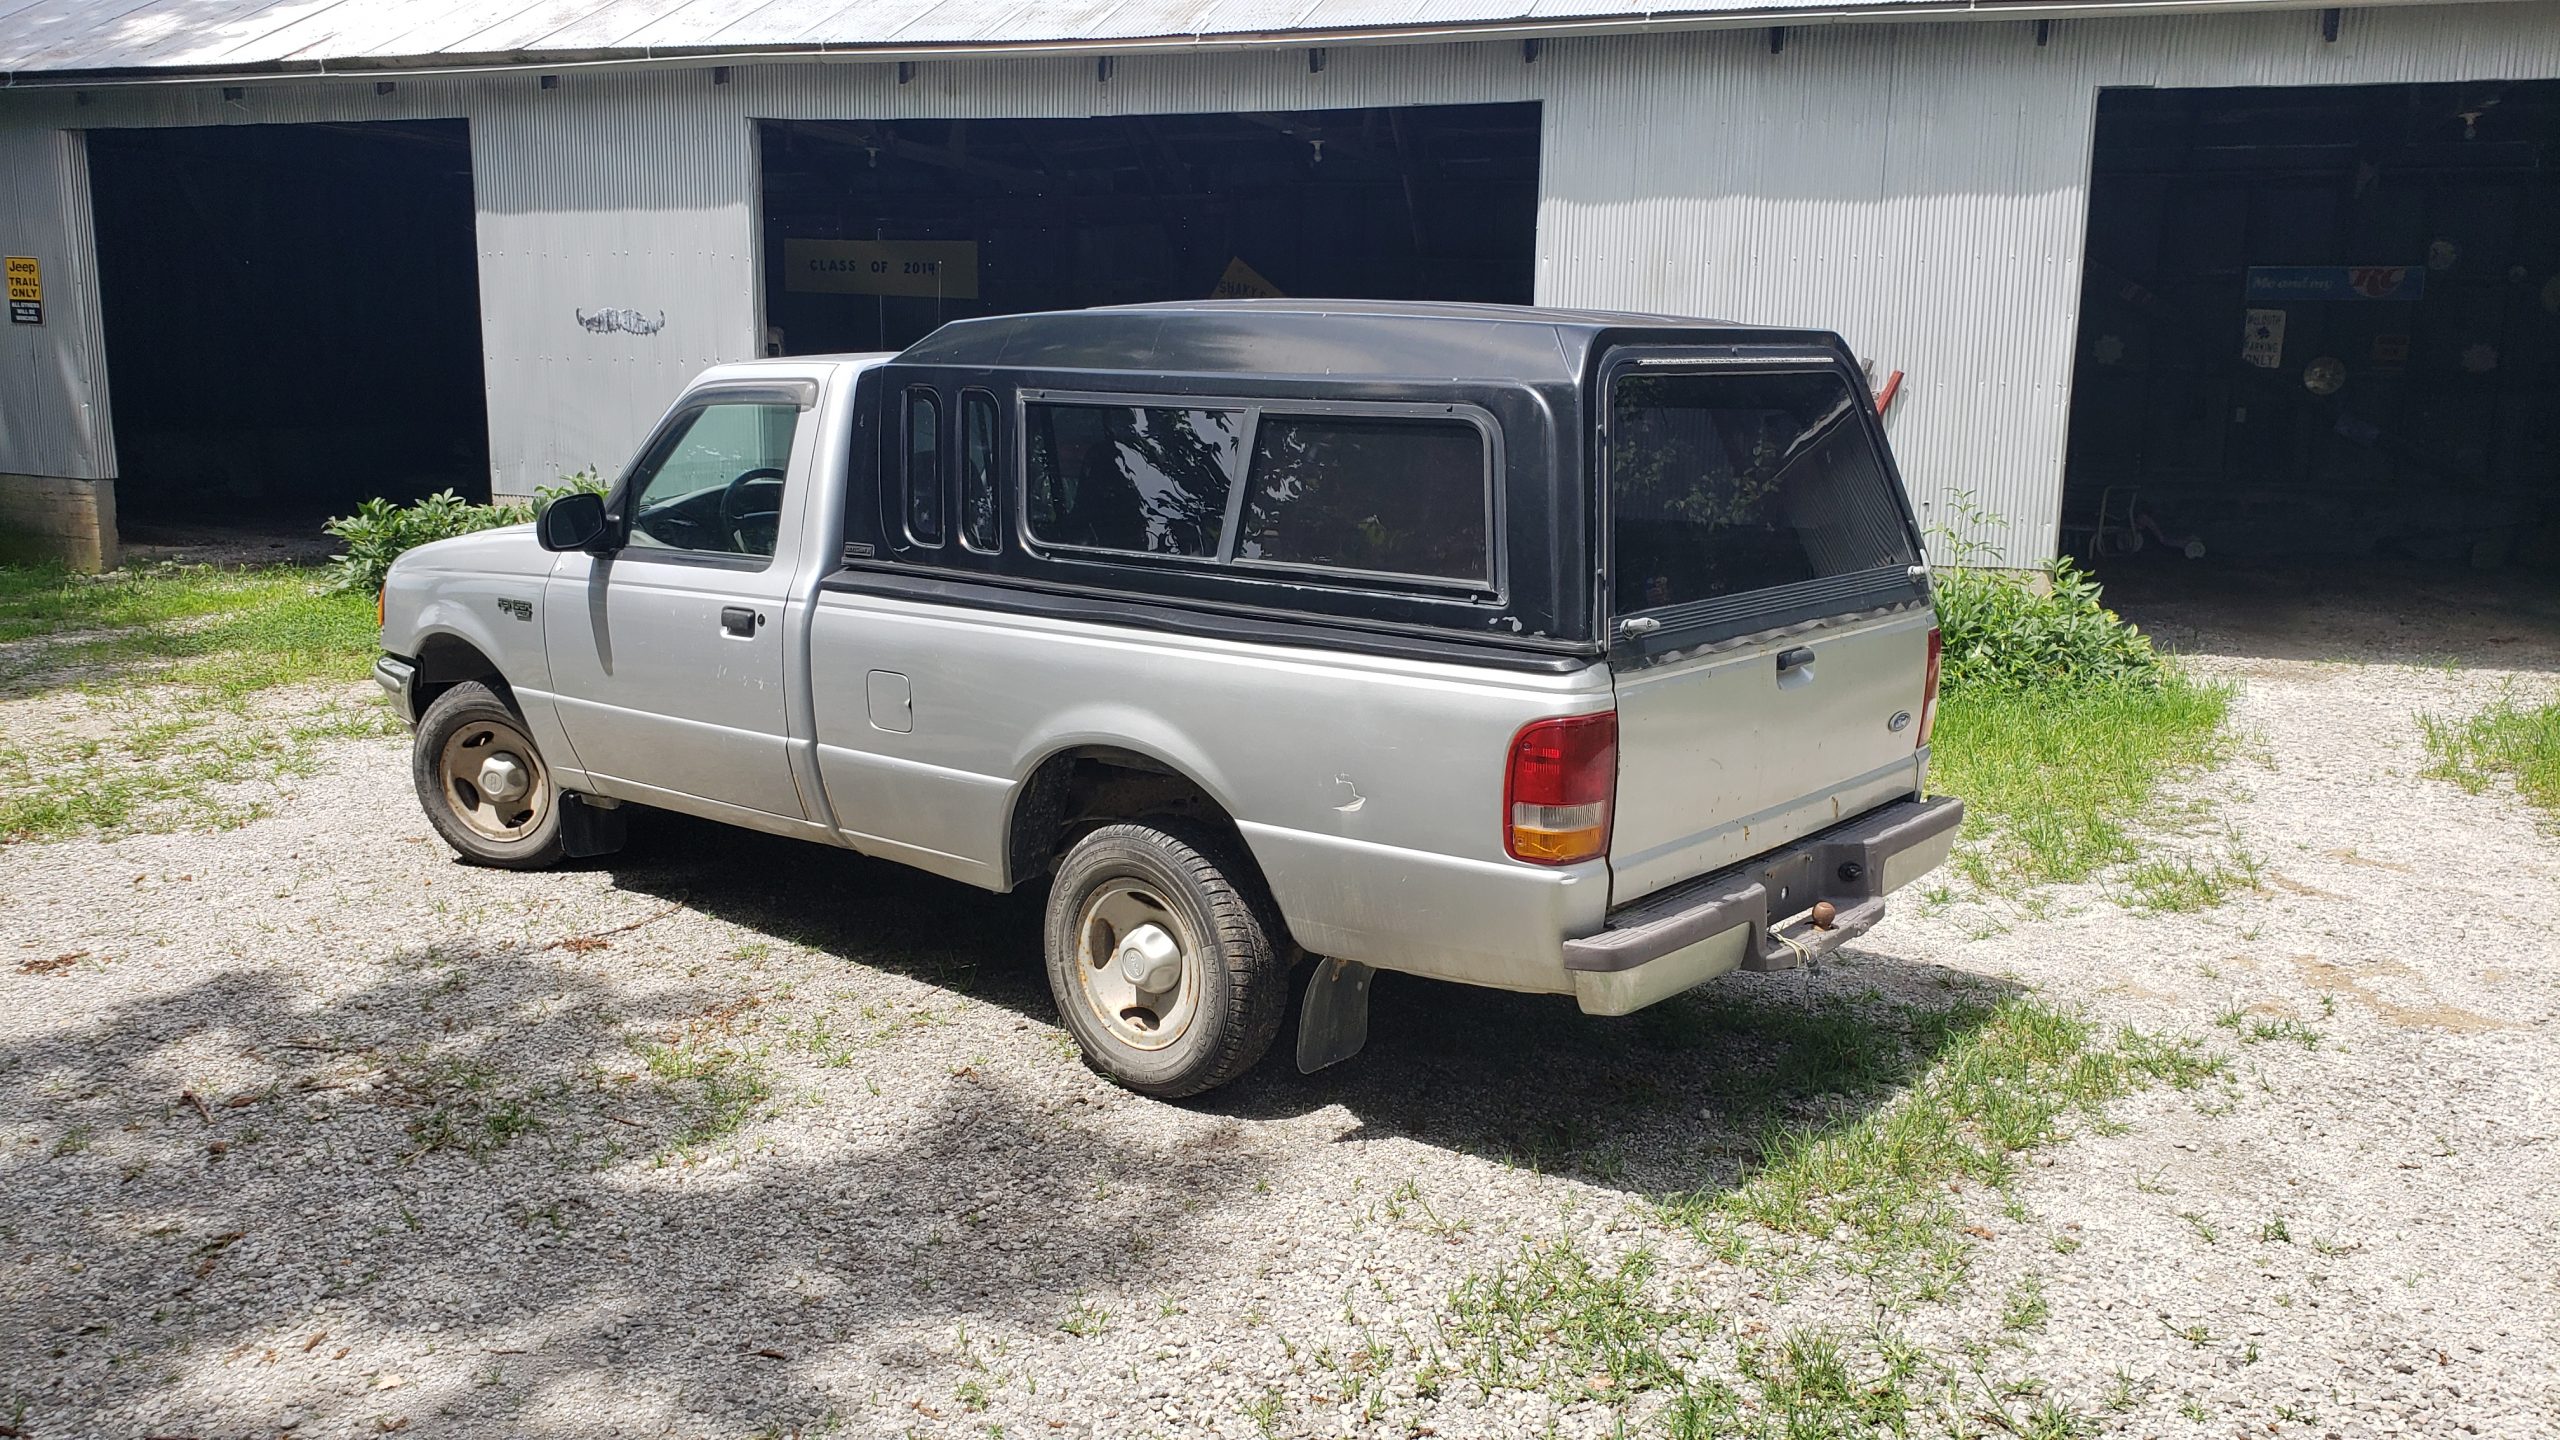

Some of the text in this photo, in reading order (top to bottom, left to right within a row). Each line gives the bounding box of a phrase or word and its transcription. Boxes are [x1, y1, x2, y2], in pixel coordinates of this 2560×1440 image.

[9, 261, 35, 274] Jeep
[809, 259, 856, 273] CLASS
[870, 260, 889, 275] OF
[9, 277, 39, 287] TRAIL
[2252, 275, 2275, 289] Me
[2278, 275, 2307, 289] and
[11, 288, 37, 297] ONLY
